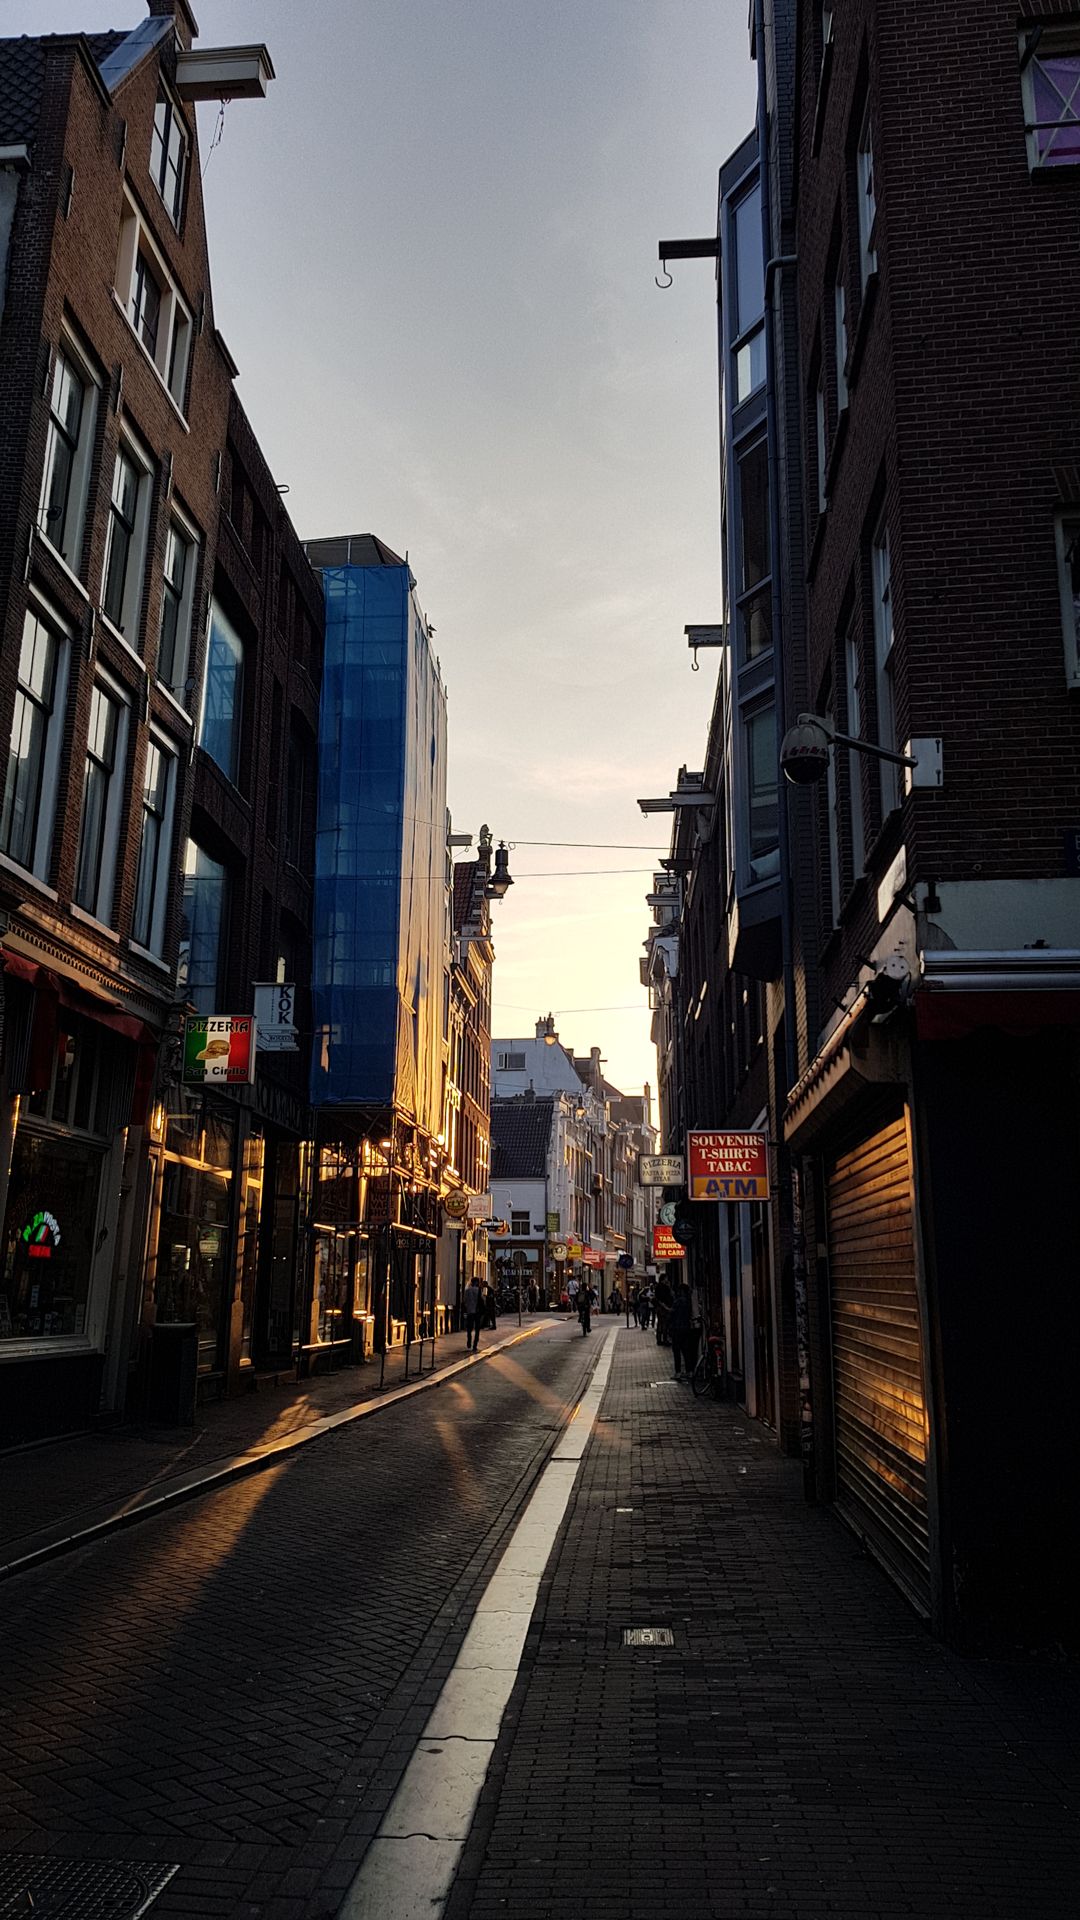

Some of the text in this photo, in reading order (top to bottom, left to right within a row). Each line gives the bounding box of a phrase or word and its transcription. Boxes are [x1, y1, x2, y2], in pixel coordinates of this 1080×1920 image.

[278, 986, 293, 1024] KOK
[188, 1021, 248, 1033] PIZZERIA
[186, 1066, 208, 1075] San
[691, 1135, 764, 1147] SOUVENIRS
[698, 1148, 758, 1159] T-SHIRTS
[643, 1158, 681, 1169] PIZZERIA
[707, 1161, 752, 1172] TABAC
[706, 1179, 757, 1197] ATM
